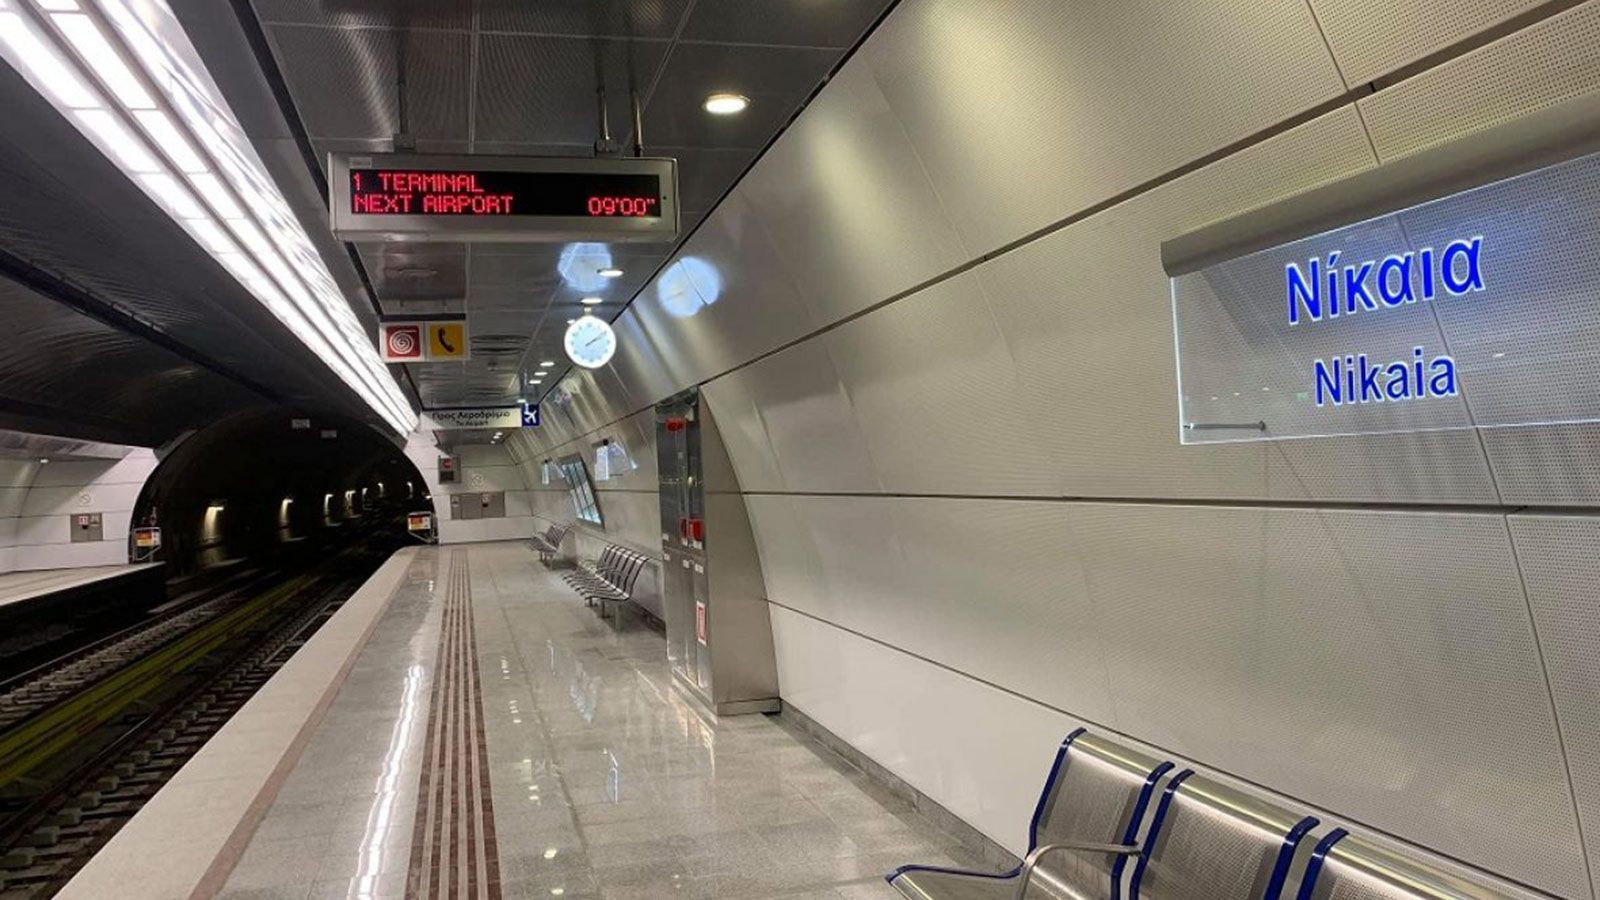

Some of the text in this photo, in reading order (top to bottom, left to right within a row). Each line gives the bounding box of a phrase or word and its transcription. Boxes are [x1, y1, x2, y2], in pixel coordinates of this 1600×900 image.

[353, 174, 485, 193] 1 TERMINAL
[354, 194, 412, 213] NEXT
[423, 195, 513, 214] AIRPORT
[1285, 235, 1486, 326] Νίκαια
[1314, 346, 1459, 407] Nikaia
